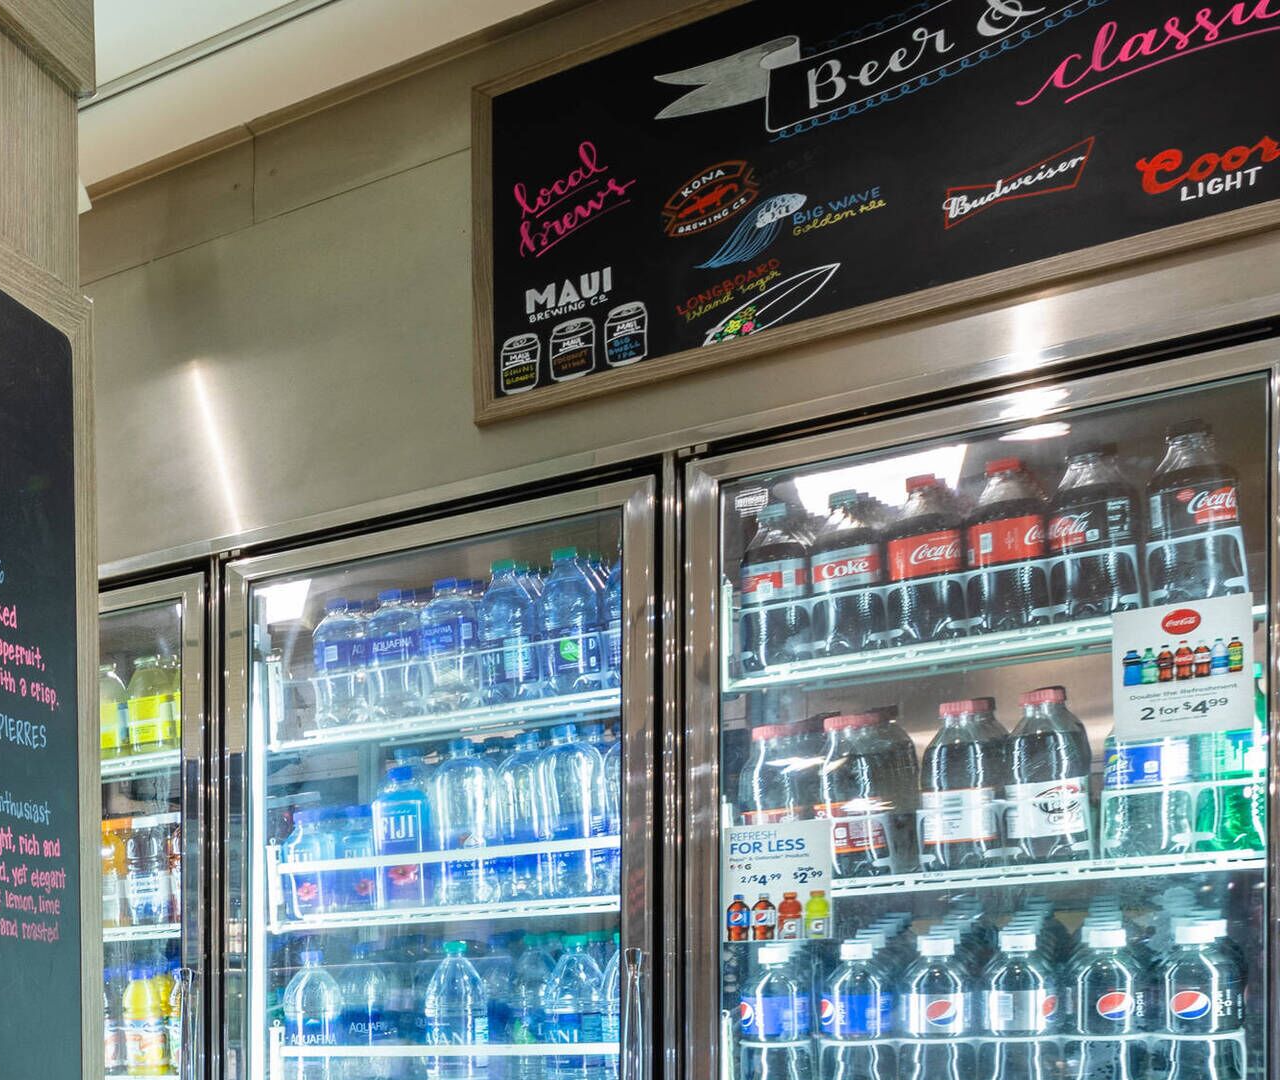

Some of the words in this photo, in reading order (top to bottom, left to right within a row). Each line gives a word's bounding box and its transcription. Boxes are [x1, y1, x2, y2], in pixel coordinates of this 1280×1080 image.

[807, 27, 955, 109] Beer
[514, 141, 608, 219] local
[681, 169, 725, 198] KONA
[942, 154, 1086, 219] Budweiser
[1180, 166, 1264, 203] LIGHT
[519, 178, 636, 257] brews
[678, 207, 729, 234] BREWING
[792, 206, 824, 226] BIG
[828, 186, 881, 212] WAVE
[793, 209, 856, 237] Golden
[525, 266, 613, 315] MAUI
[675, 258, 781, 316] LONGBOARD
[529, 301, 586, 323] BREWING
[822, 559, 869, 577] Coke
[372, 636, 413, 651] AQUAFINA
[1140, 706, 1155, 721] 2
[1159, 706, 1179, 715] for
[730, 830, 777, 841] REFRESH
[730, 842, 762, 855] FOR
[768, 838, 805, 852] LESS
